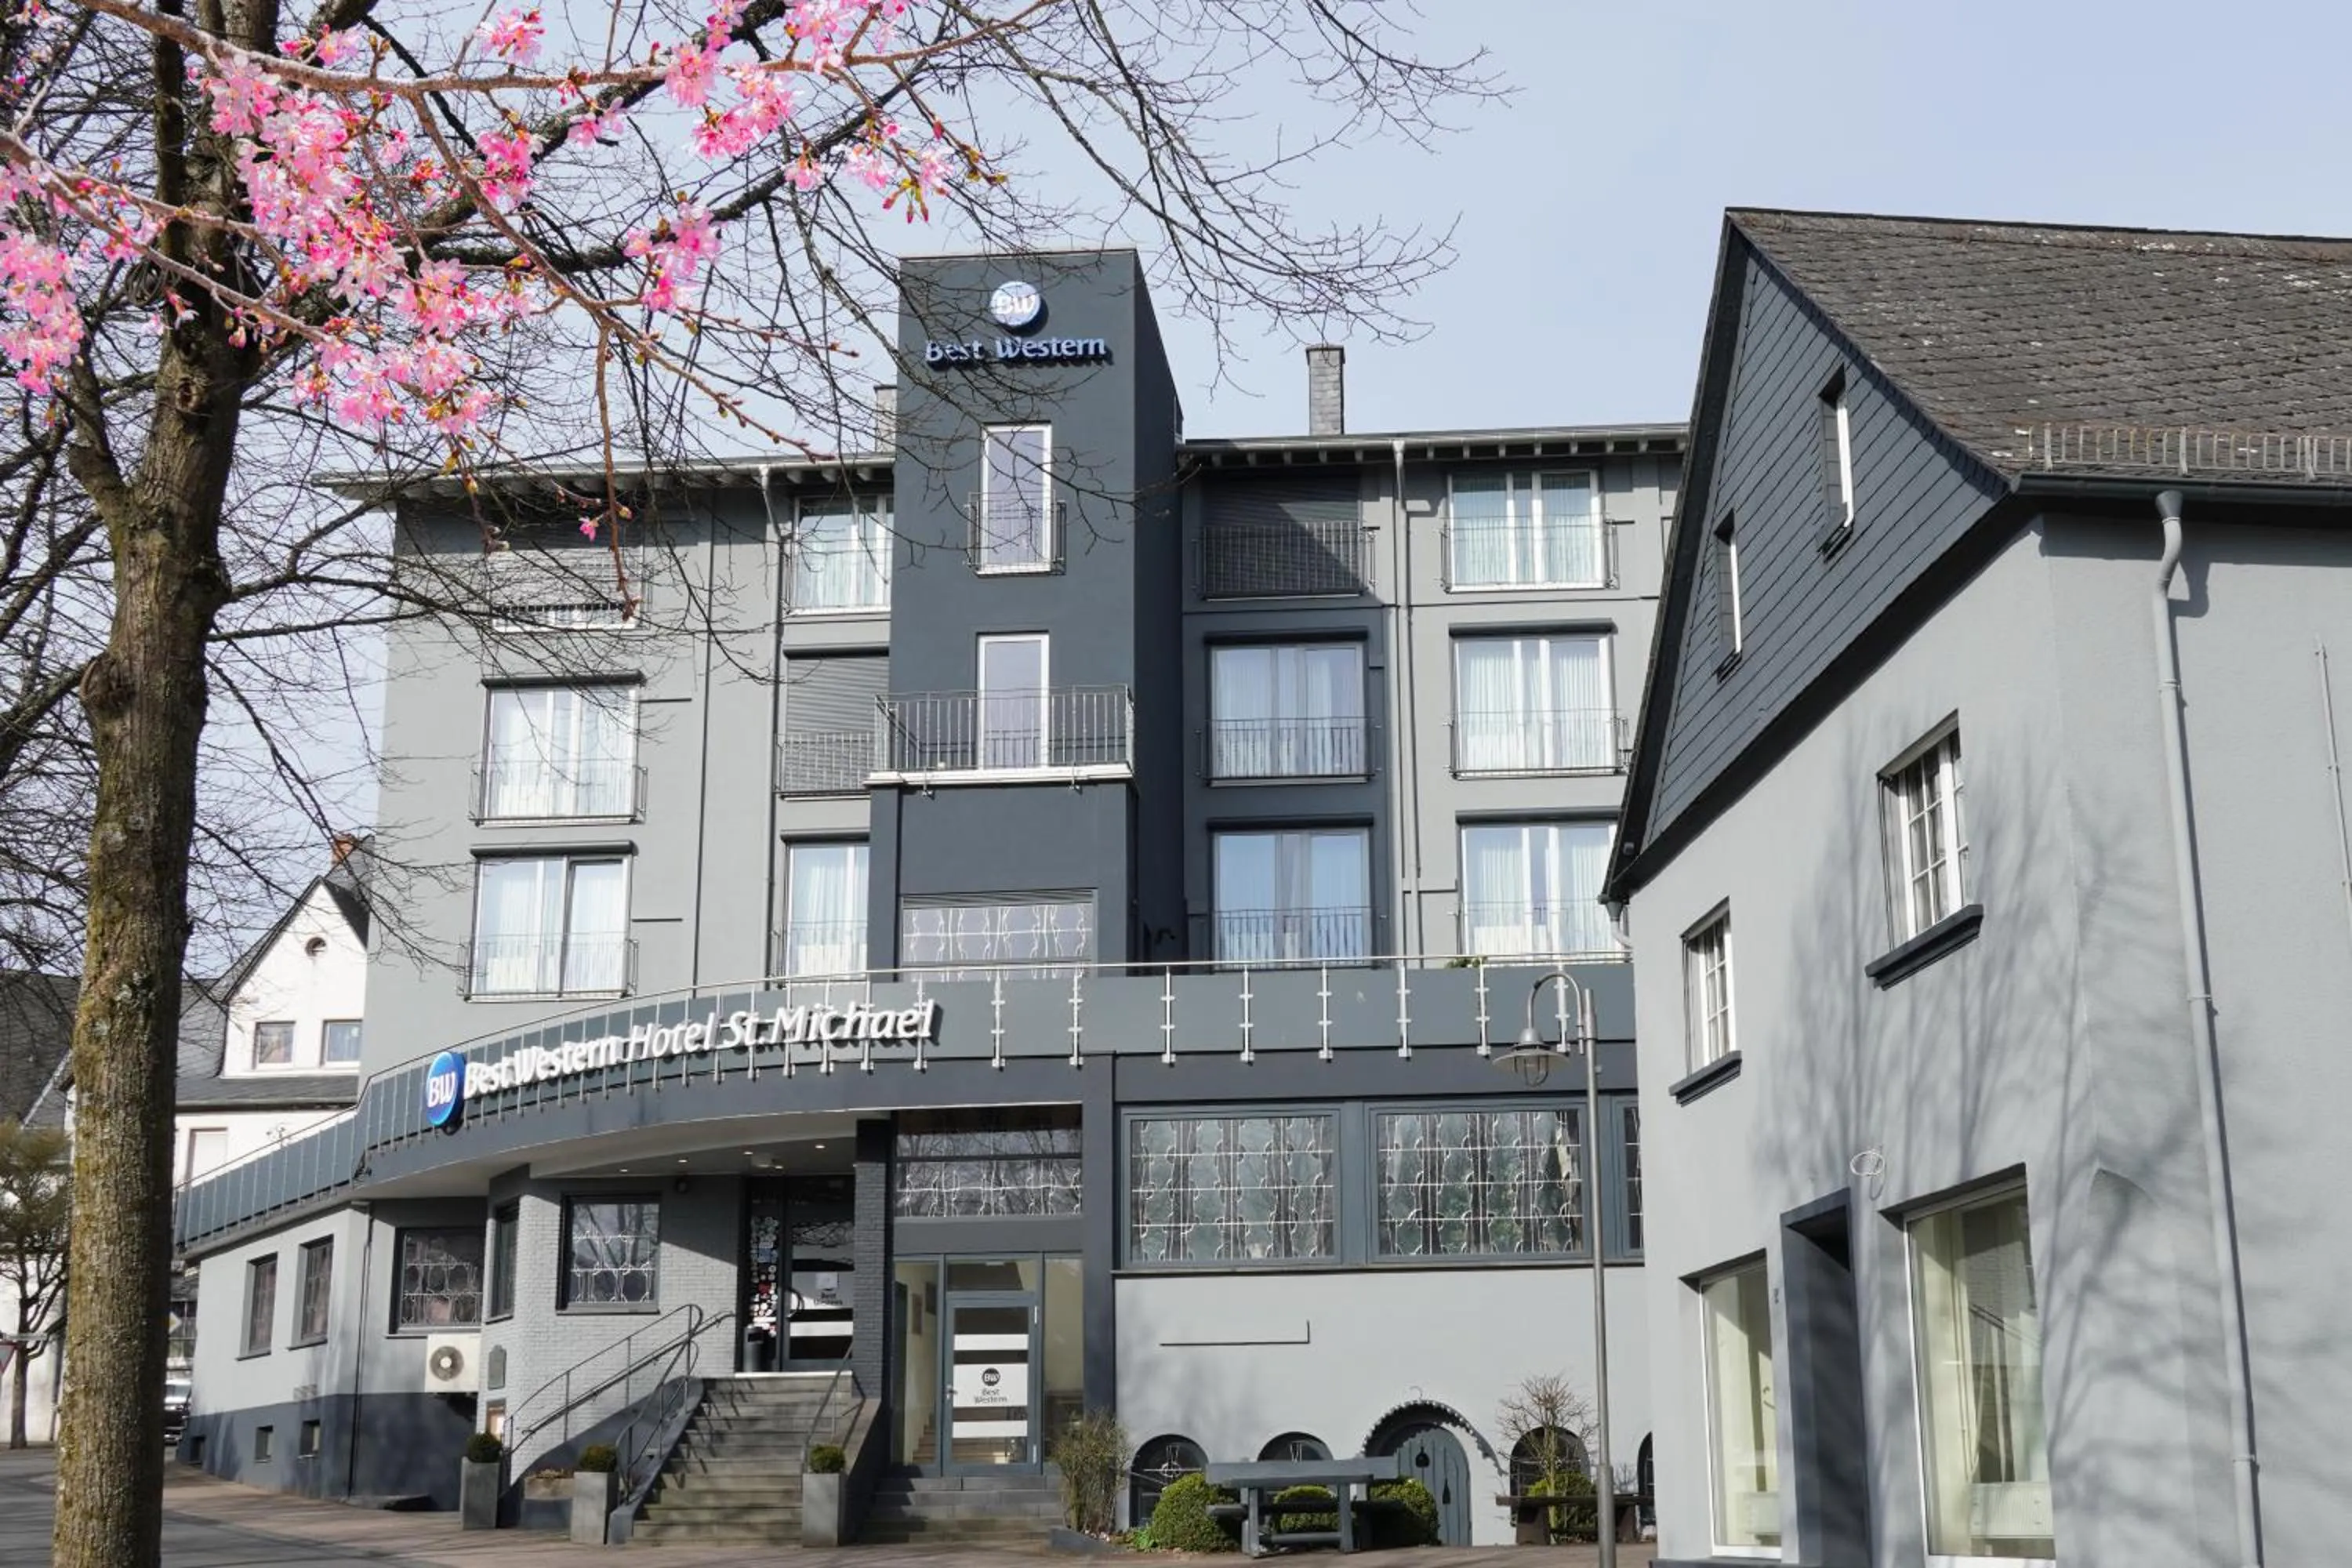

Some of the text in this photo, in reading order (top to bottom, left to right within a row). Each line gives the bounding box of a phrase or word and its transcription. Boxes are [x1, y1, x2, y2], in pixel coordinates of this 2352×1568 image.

[925, 336, 1106, 361] Best Western
[463, 1057, 513, 1098] Best
[514, 1036, 618, 1085] Western
[628, 1012, 716, 1059] Hotel
[427, 1073, 456, 1108] BW
[984, 1373, 1000, 1382] BW
[974, 1396, 1007, 1404] Western
